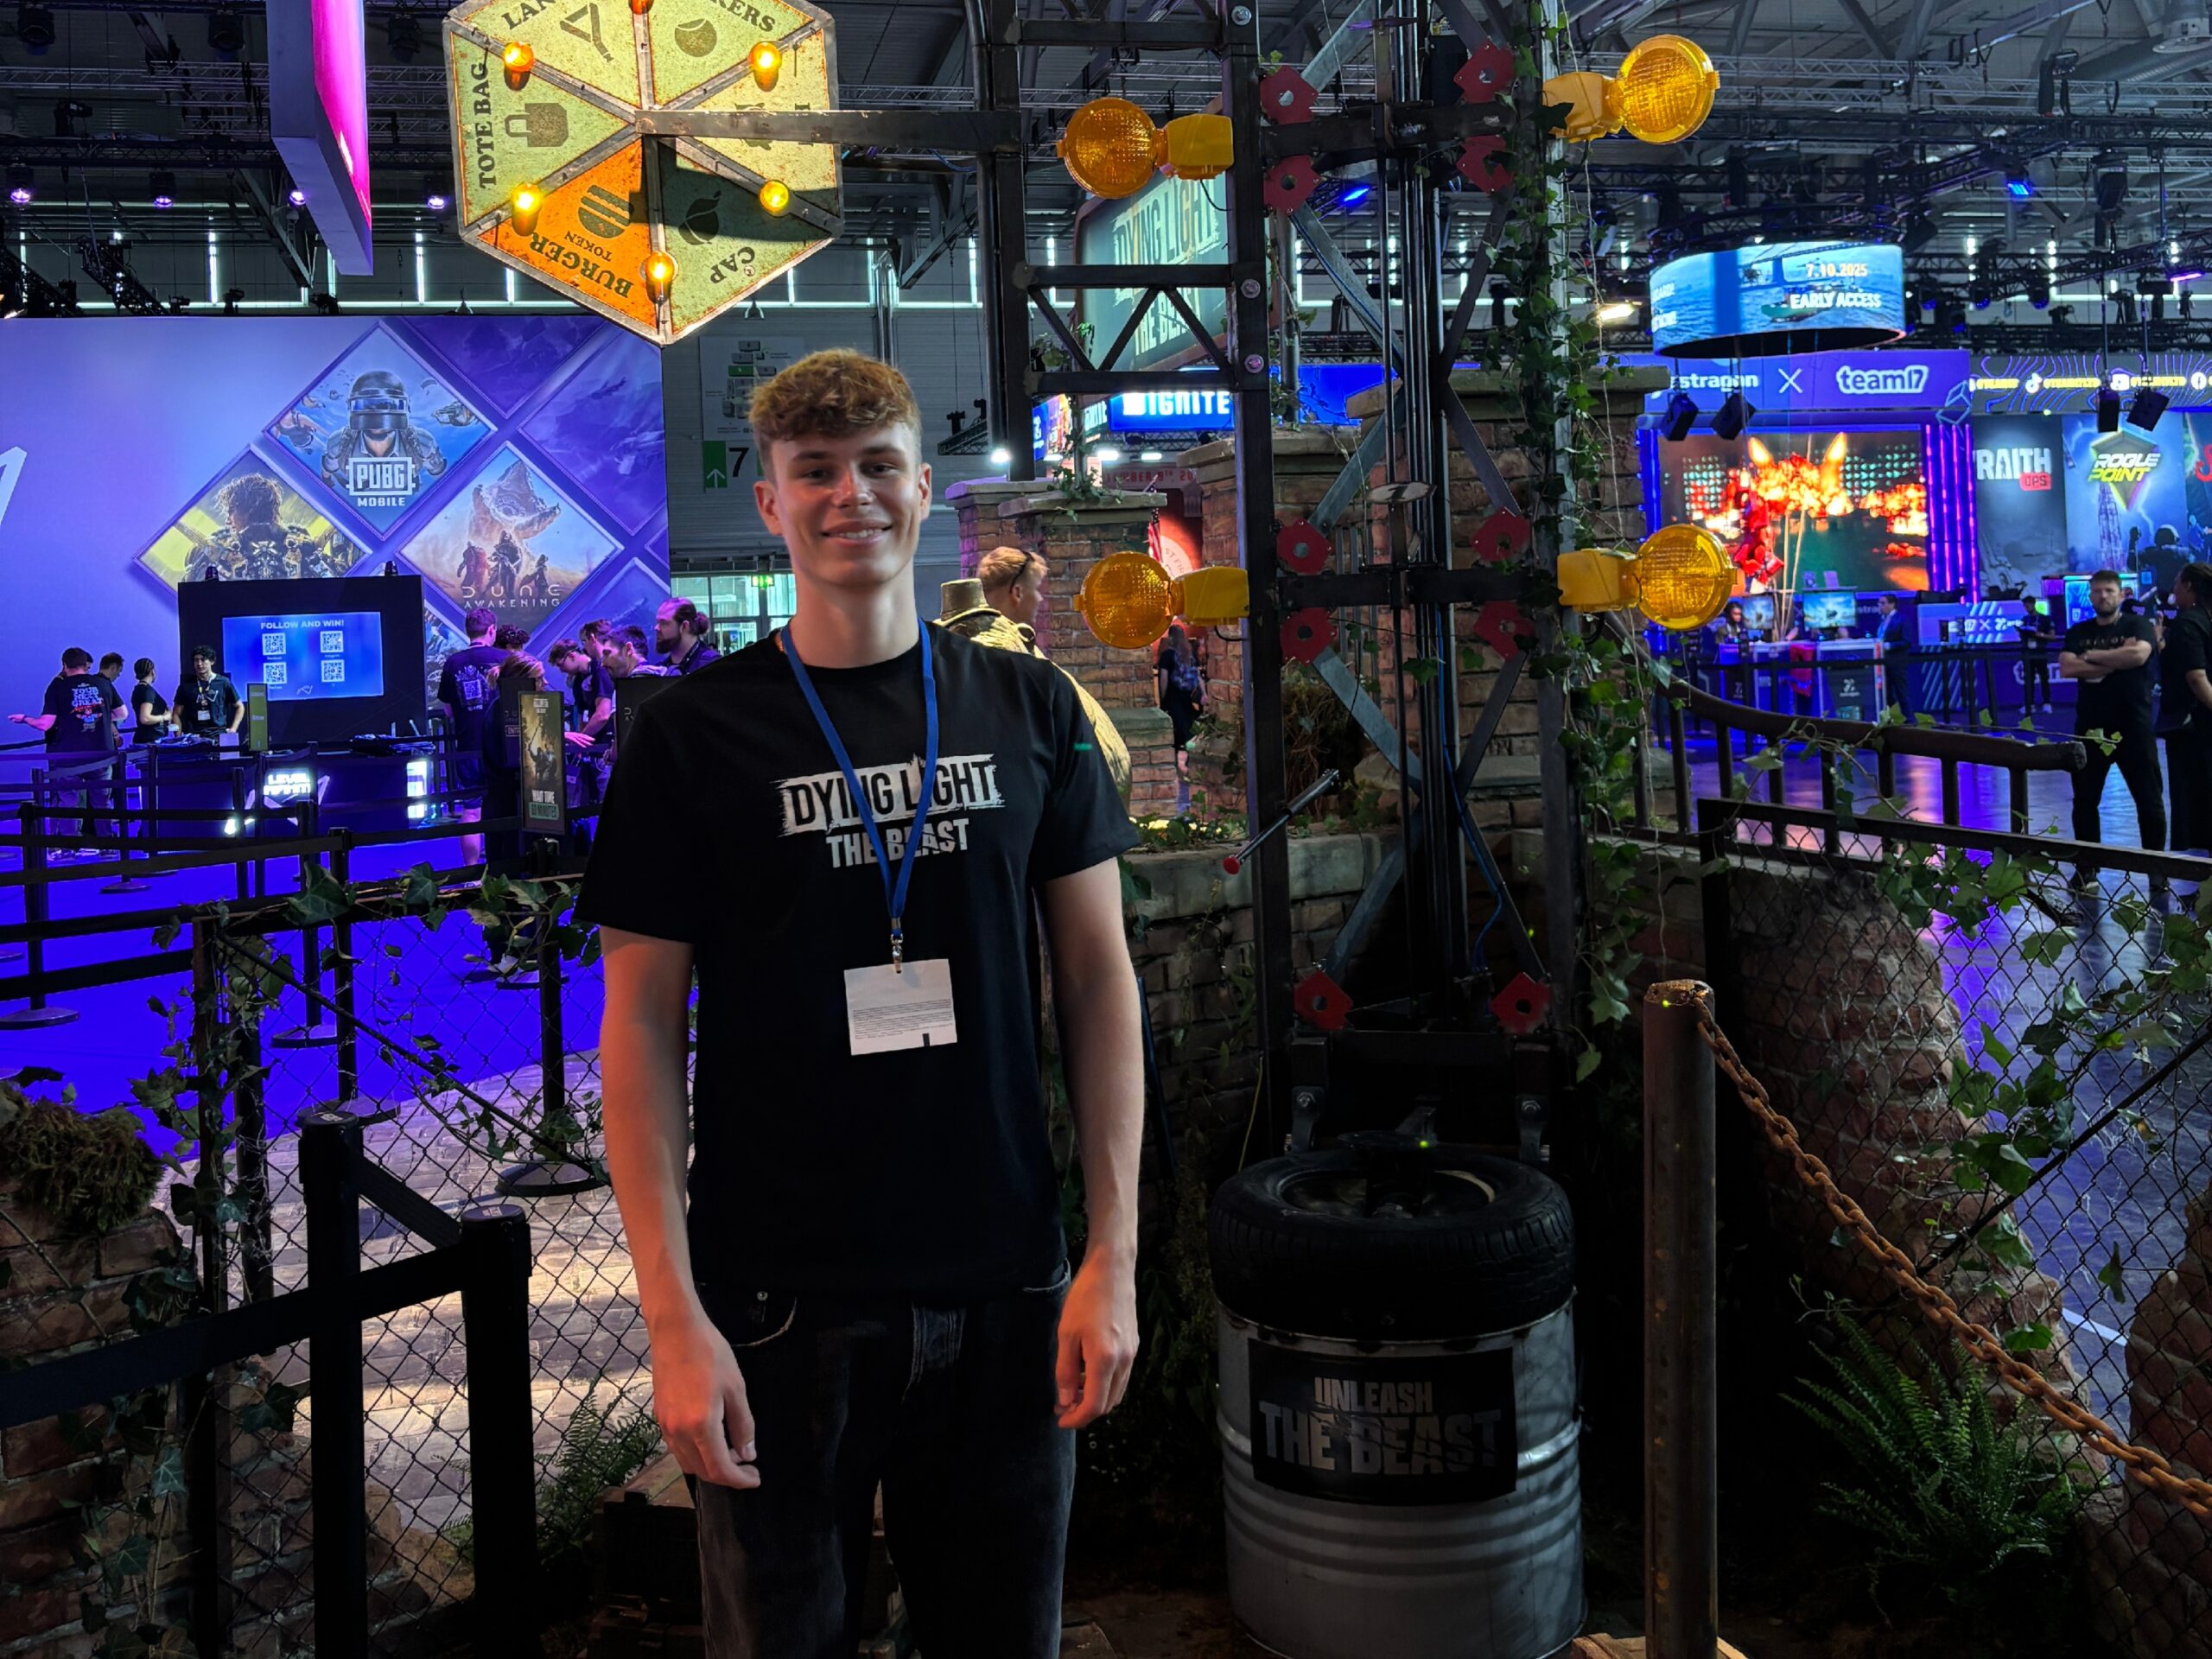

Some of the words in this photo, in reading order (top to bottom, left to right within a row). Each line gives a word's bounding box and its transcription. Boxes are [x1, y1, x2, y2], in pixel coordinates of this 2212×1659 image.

[470, 62, 491, 116] BAG
[476, 121, 497, 189] TOTE
[563, 230, 612, 263] TOKEN
[530, 232, 635, 299] BURGER
[709, 245, 755, 284] CAP
[1806, 263, 1867, 277] 7.10.2025
[1790, 293, 1835, 309] EARLY
[1836, 292, 1881, 308] ACCESS
[1837, 365, 1929, 393] team17
[357, 463, 406, 489] PUBG
[728, 447, 750, 478] 7
[2088, 467, 2152, 483] POINT
[2024, 475, 2048, 487] OPS
[357, 497, 406, 507] MOBILE
[462, 584, 562, 598] DUNE
[463, 598, 562, 608] AWAKENING
[260, 620, 299, 630] FOLLOW
[322, 619, 345, 627] WIN!
[1314, 1376, 1433, 1414] UNLEASH
[1258, 1401, 1336, 1471] THE
[1350, 1408, 1503, 1476] BEAST
